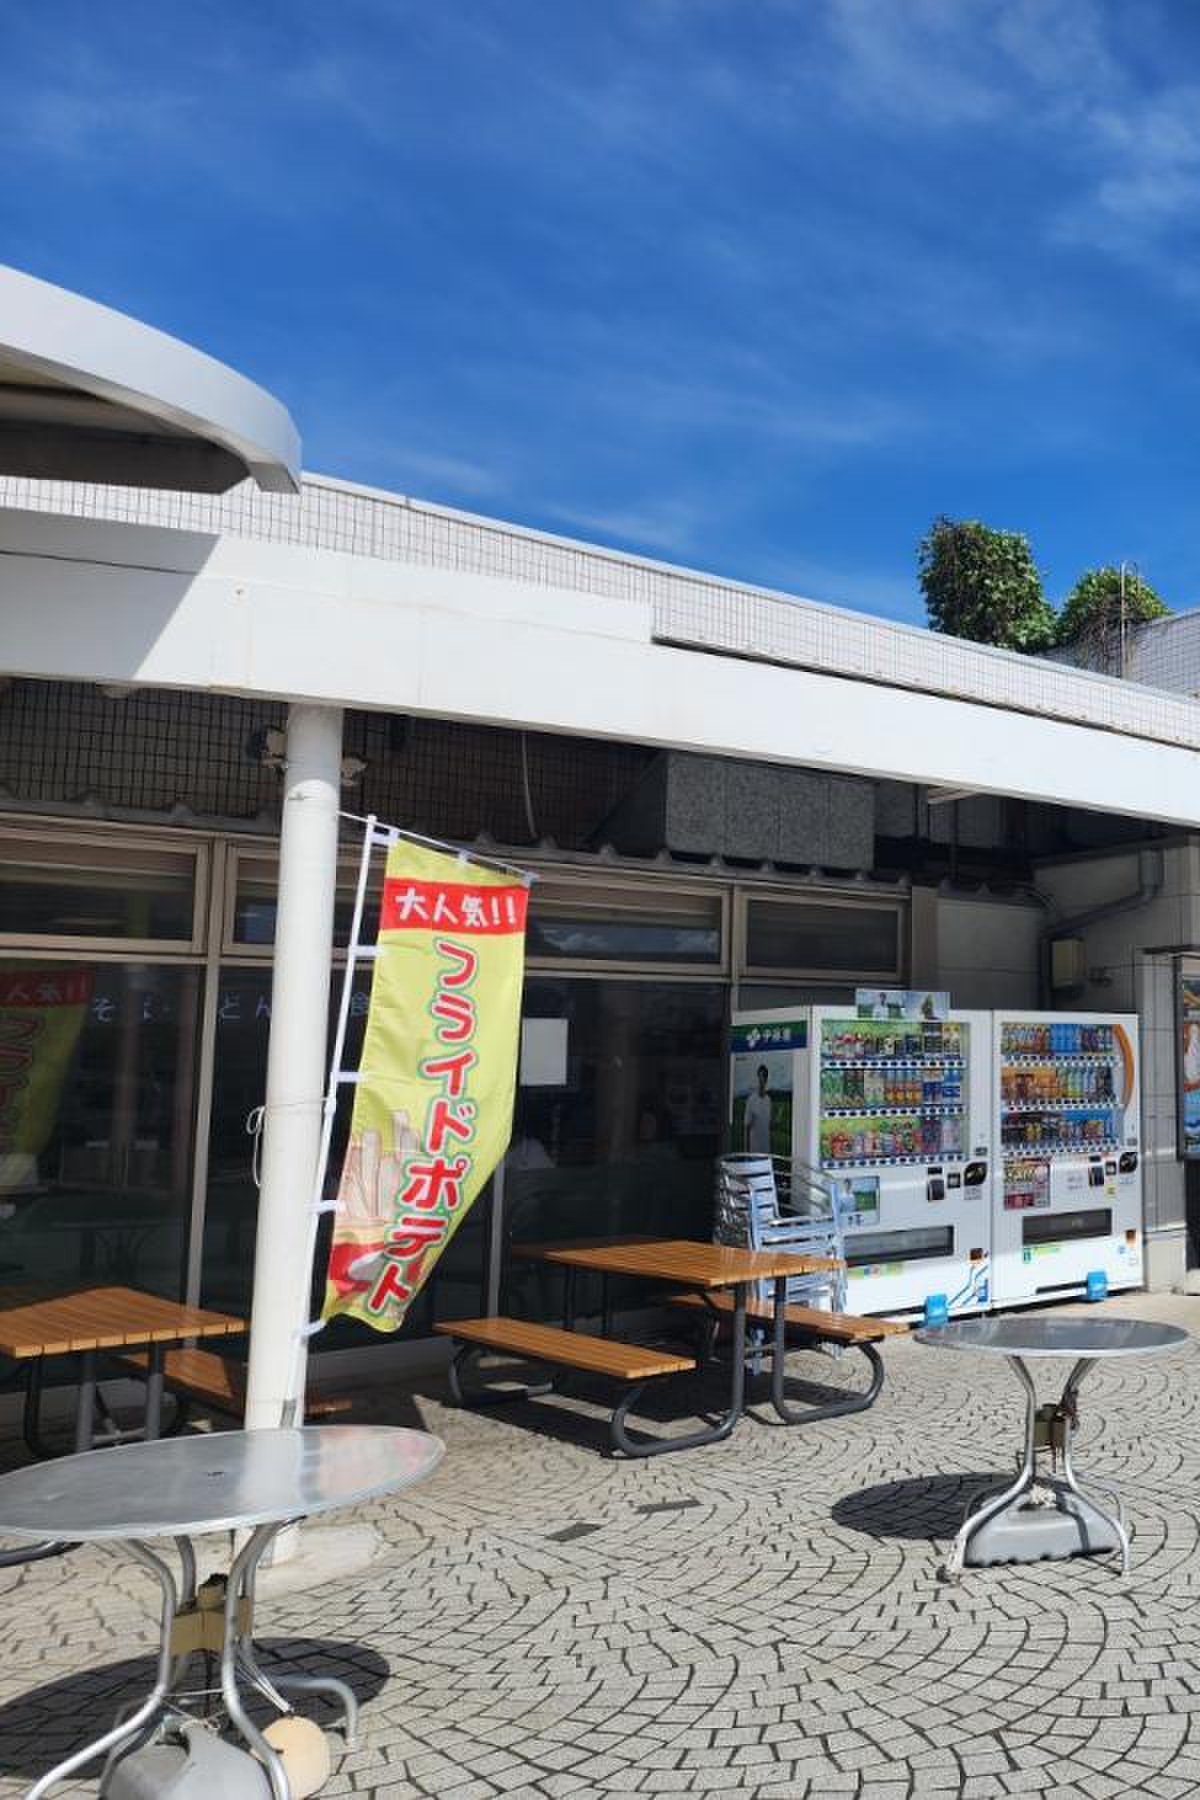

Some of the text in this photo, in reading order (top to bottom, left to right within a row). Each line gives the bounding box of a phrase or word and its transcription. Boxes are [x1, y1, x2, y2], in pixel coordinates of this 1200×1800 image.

[395, 888, 517, 928] 大人気!!
[368, 940, 478, 1312] フライドポテト
